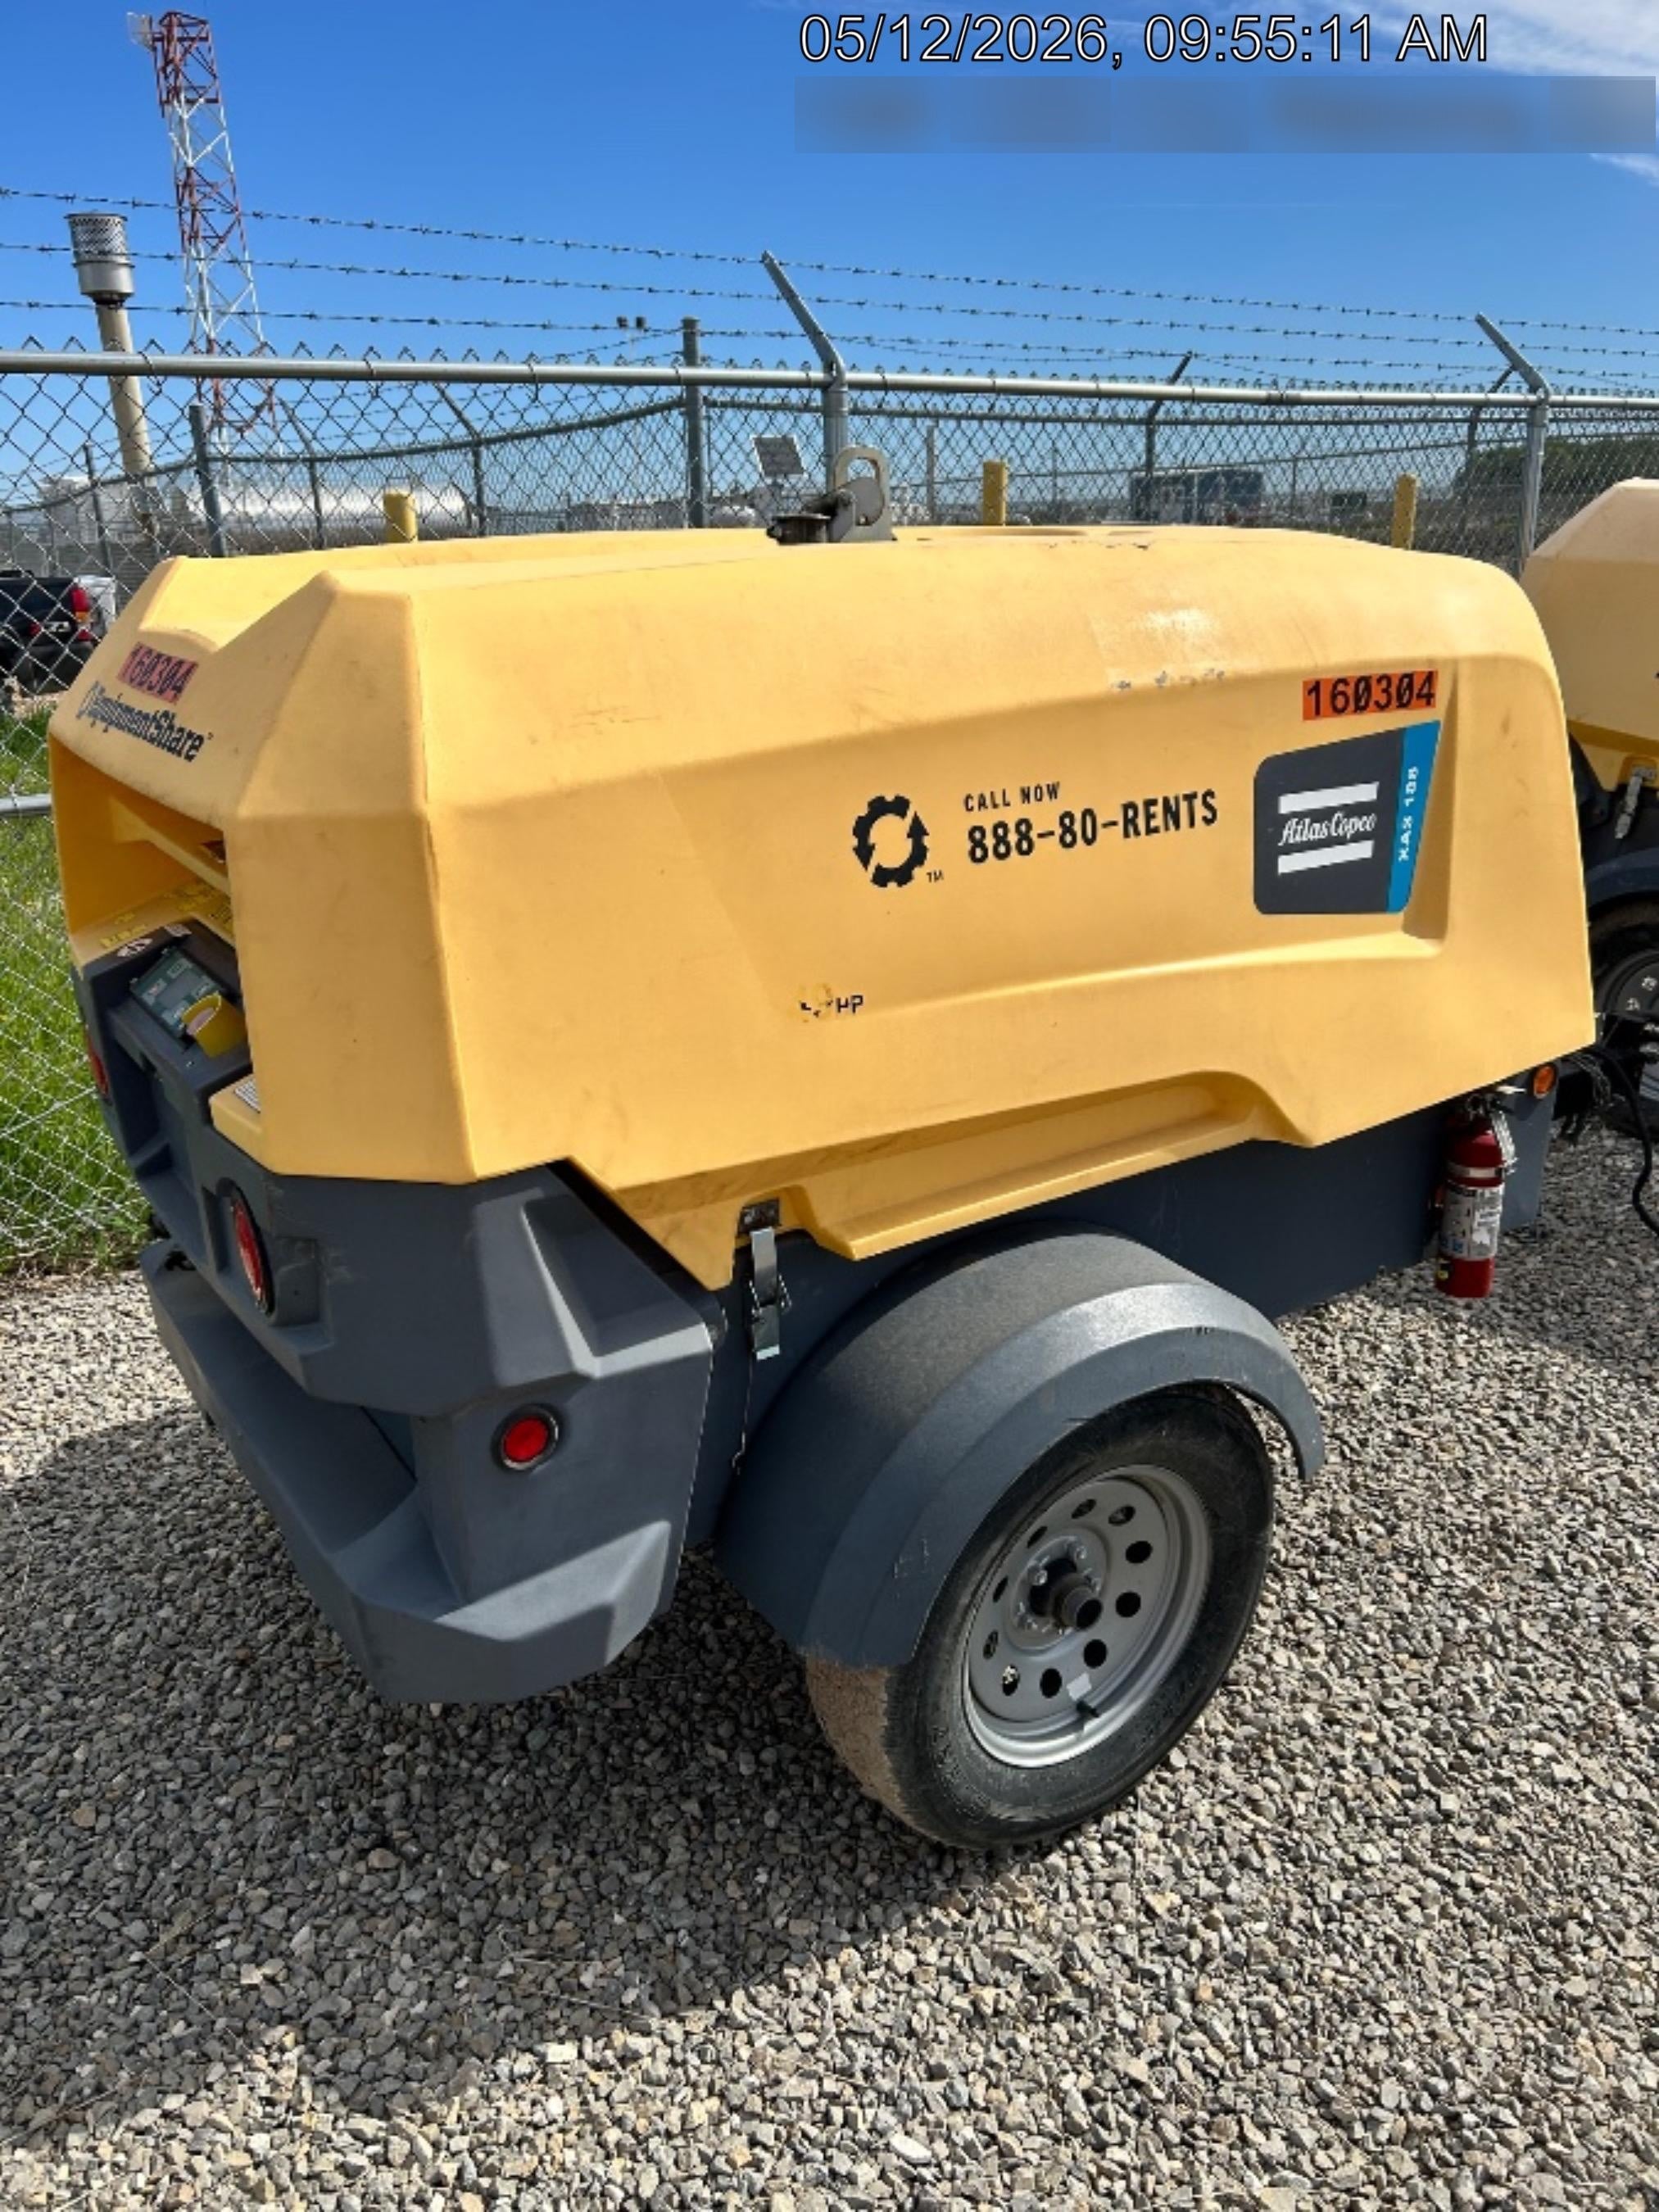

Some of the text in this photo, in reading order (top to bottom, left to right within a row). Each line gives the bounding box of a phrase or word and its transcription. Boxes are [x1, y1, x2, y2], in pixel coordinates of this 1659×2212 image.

[1307, 670, 1435, 717] 160304
[964, 781, 1060, 813] CALL NOW
[968, 789, 1218, 864] 888-80-RENTS
[836, 995, 863, 1014] HP
